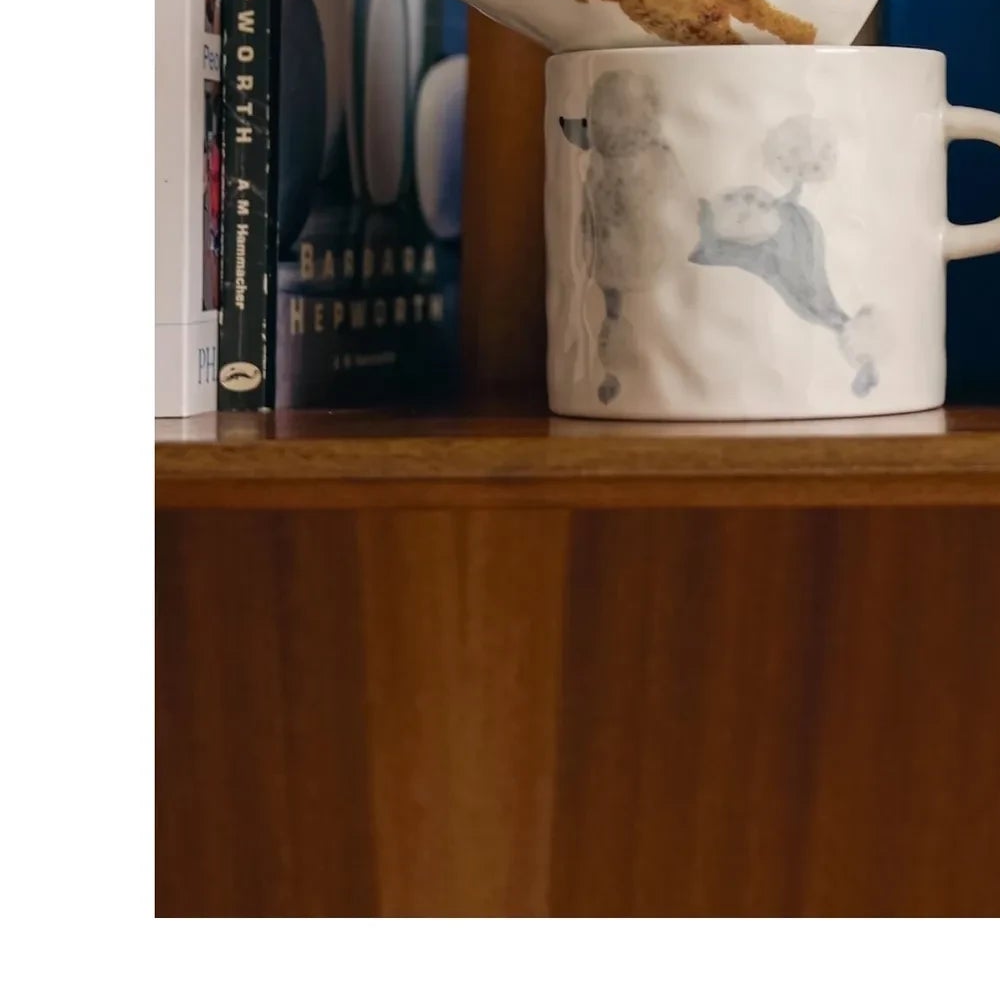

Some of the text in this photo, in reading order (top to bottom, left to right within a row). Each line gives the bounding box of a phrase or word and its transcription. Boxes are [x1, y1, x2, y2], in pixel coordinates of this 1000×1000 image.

[236, 178, 249, 190] A
[235, 201, 249, 216] M
[235, 224, 250, 311] Hammacher
